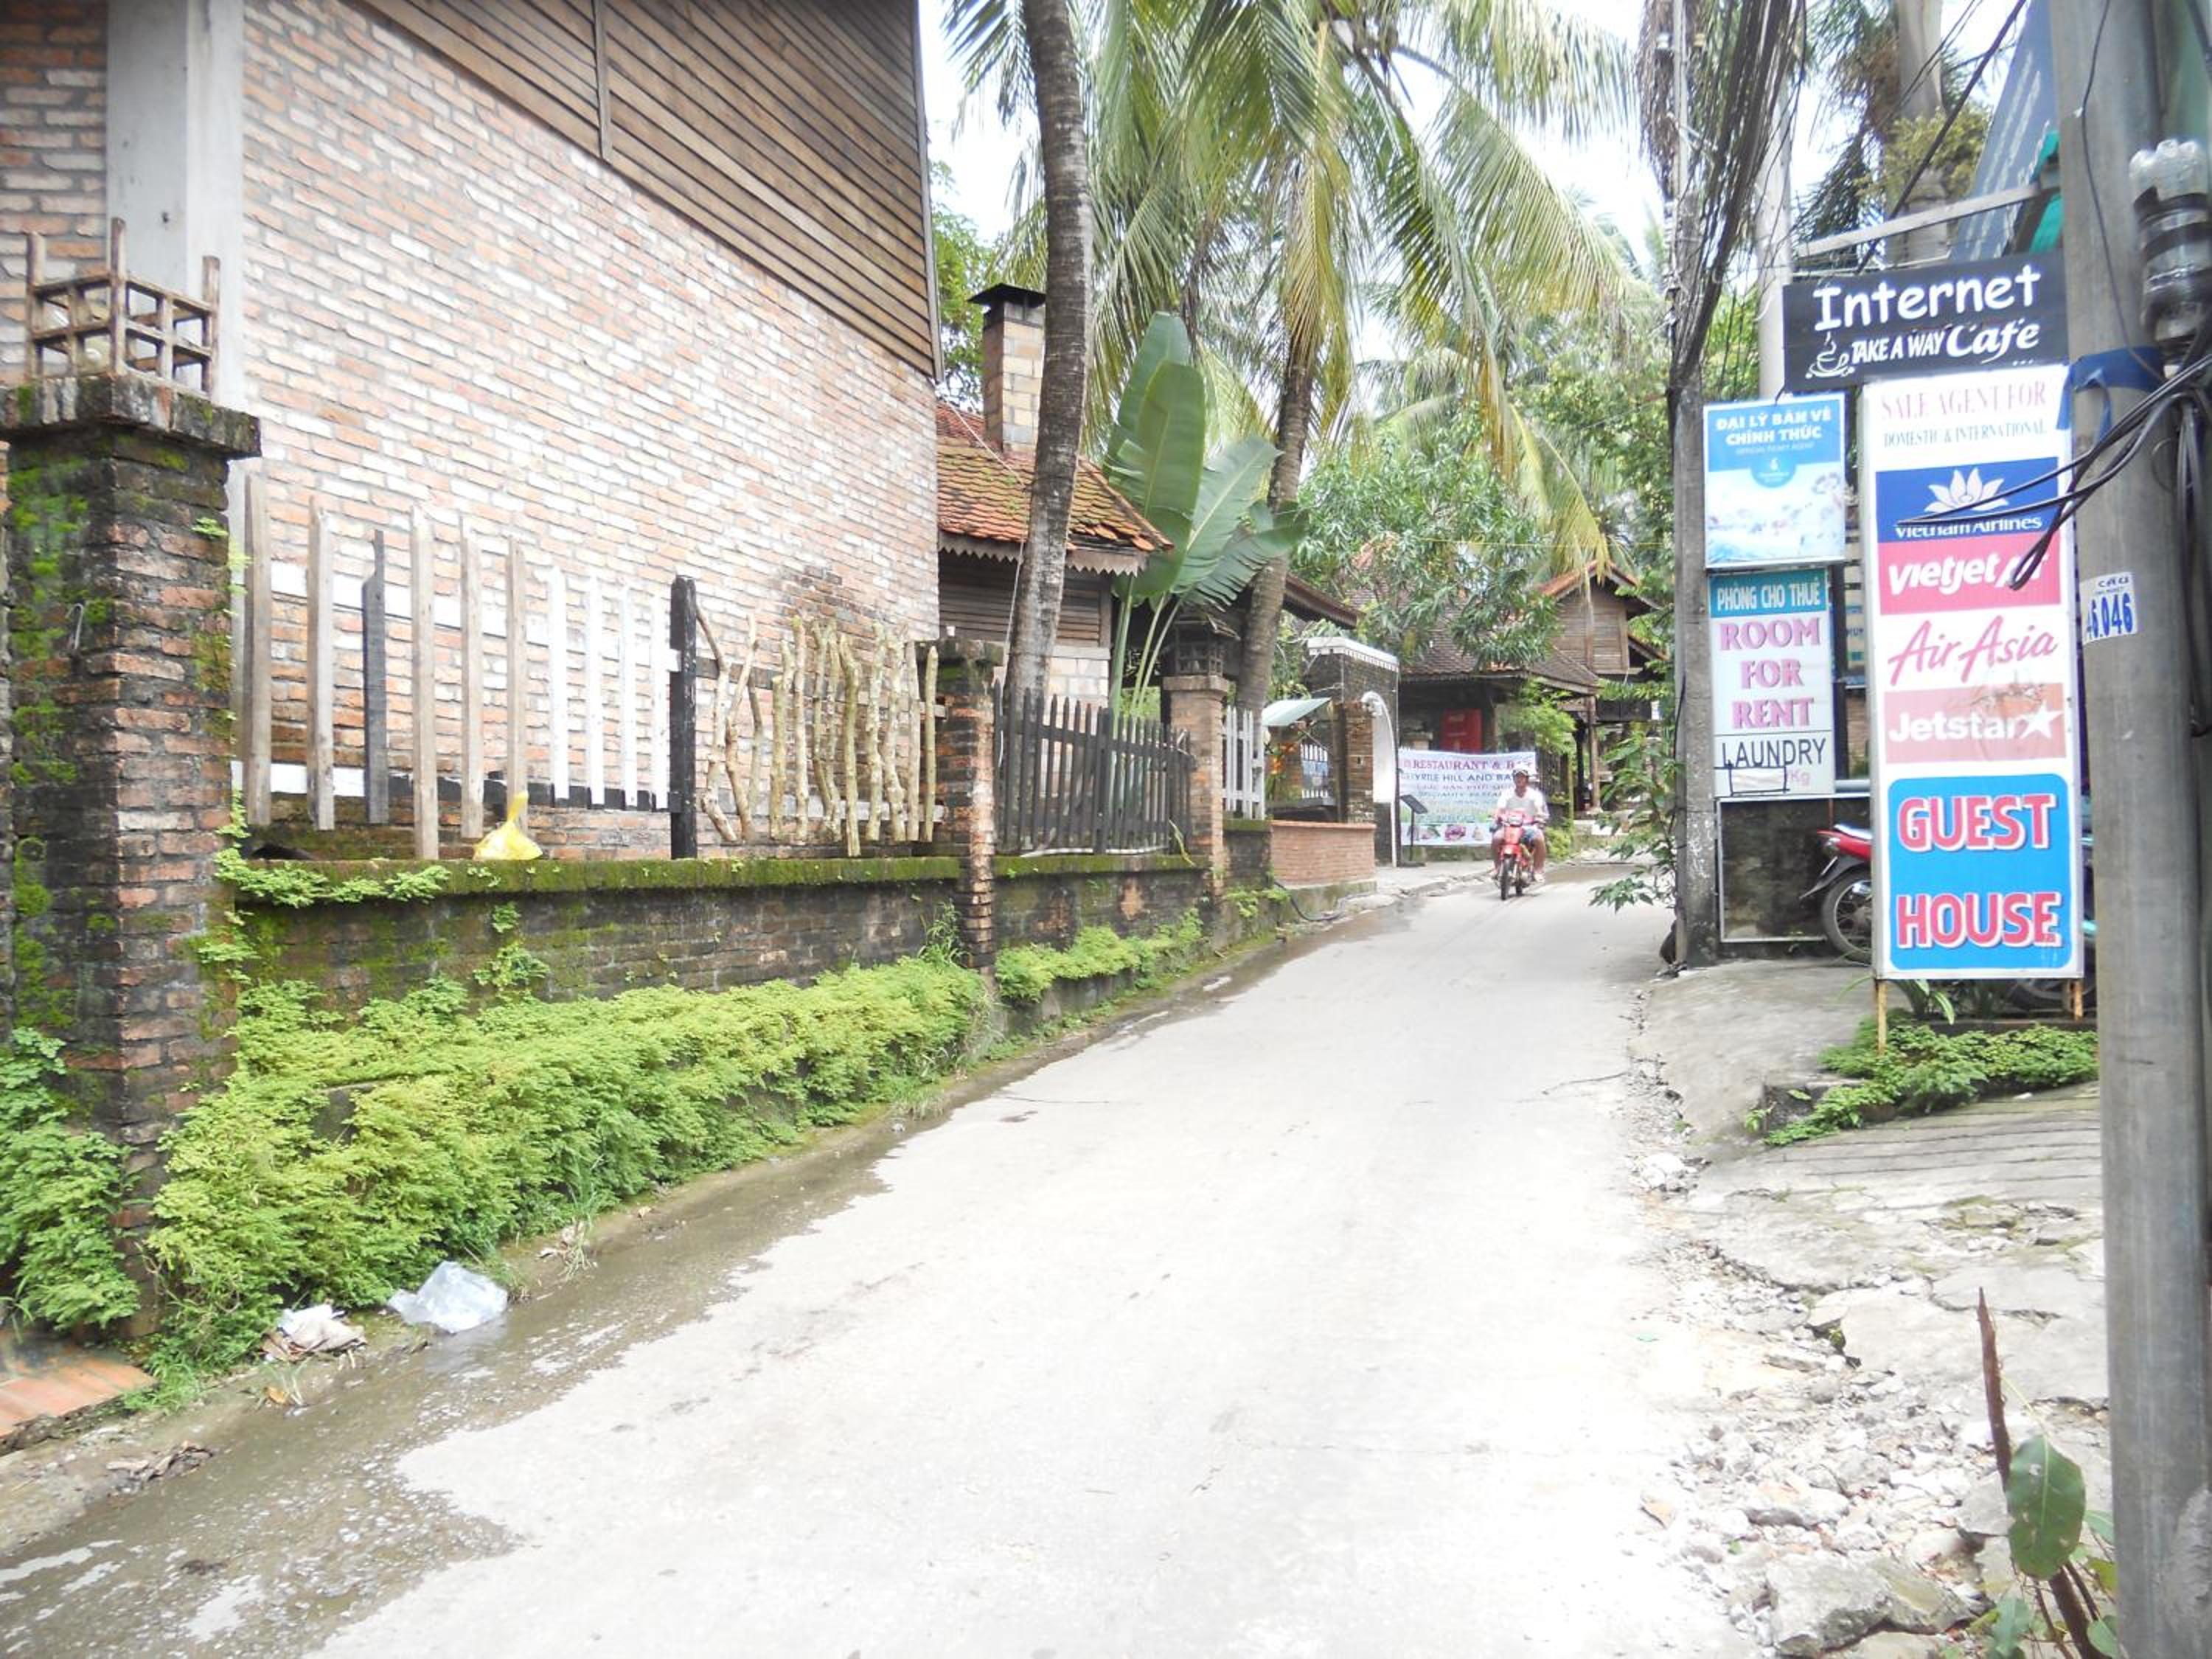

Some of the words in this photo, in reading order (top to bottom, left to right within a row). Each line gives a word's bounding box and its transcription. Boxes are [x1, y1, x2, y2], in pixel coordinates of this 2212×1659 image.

[1813, 264, 2041, 331] Internet
[1851, 337, 1889, 364] TAKE
[1890, 335, 1904, 361] A
[1907, 330, 1945, 358] WAY
[1938, 385, 2000, 416] AGENT
[2007, 380, 2046, 410] FOR
[1955, 417, 2047, 443] INTERNATIONAL
[1972, 516, 2043, 534] Airlines
[1761, 583, 1786, 609] CHO
[1719, 616, 1821, 651] ROOM
[1740, 658, 1805, 689] FOR
[1733, 697, 1815, 728] RENT
[1888, 710, 2022, 742] Jetstar
[1413, 759, 1488, 770] RESTAURANT
[1492, 760, 1500, 769] &
[1722, 738, 1826, 768] LAUNDRY
[1443, 774, 1464, 782] HILL
[1467, 773, 1493, 782] AND
[1496, 773, 1512, 782] BA
[1897, 793, 2057, 853] GUEST
[1896, 892, 2065, 949] HOUSE
